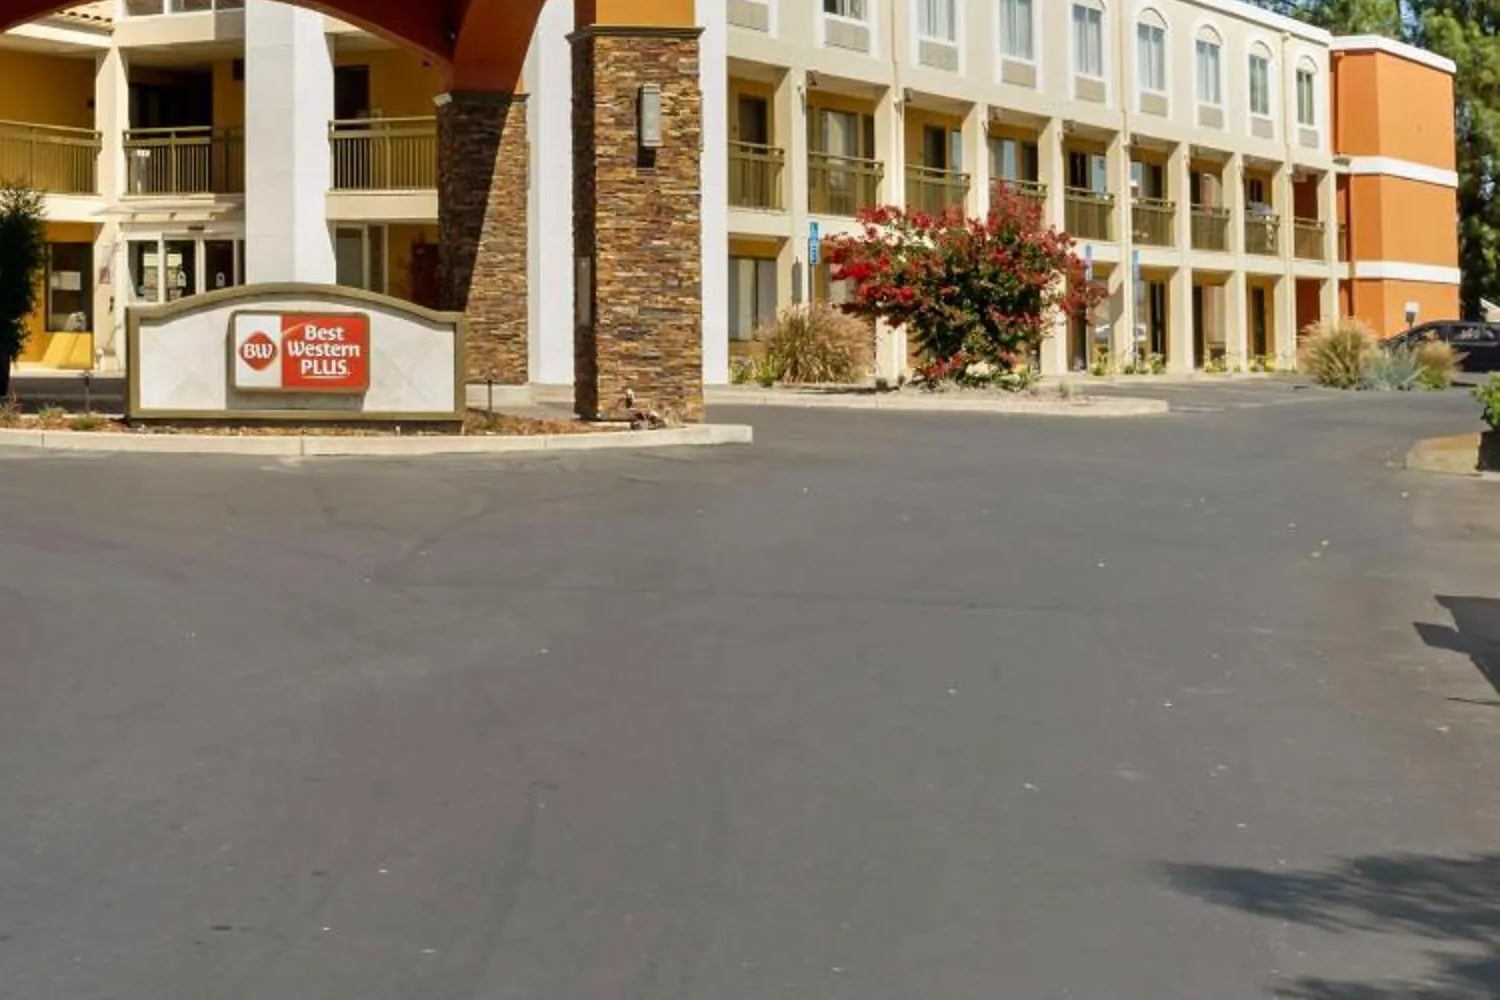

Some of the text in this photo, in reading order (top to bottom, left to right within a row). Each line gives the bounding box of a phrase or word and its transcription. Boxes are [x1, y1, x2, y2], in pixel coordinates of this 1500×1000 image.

[305, 324, 344, 341] Best
[243, 343, 273, 358] BW
[287, 341, 361, 357] Western
[301, 359, 349, 375] PLUS
